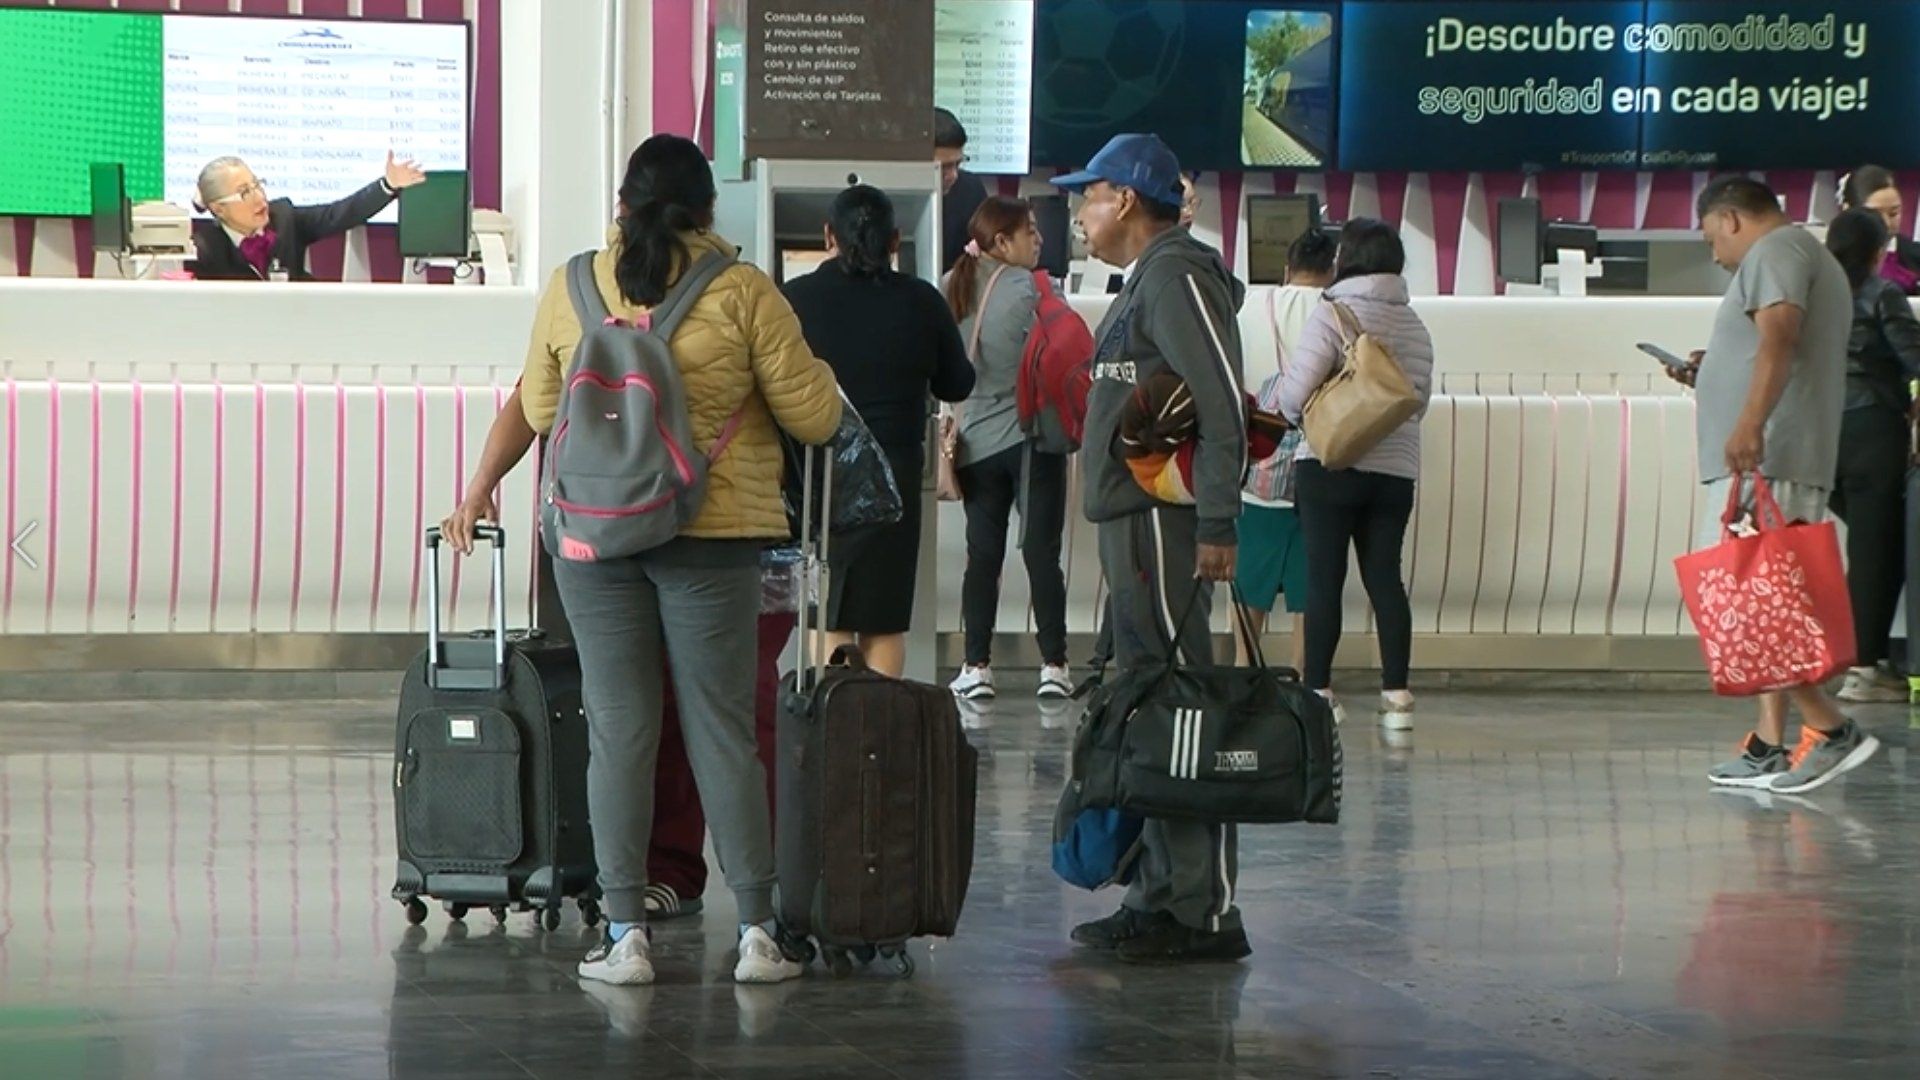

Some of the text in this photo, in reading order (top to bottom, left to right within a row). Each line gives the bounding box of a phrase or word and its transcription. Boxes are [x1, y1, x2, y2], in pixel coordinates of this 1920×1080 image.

[765, 11, 866, 24] Consulta de saldos
[764, 28, 843, 39] y movimientos
[1425, 13, 1868, 58] ¡Descubre comodidad y
[764, 43, 861, 55] Retiro de efectivo
[764, 59, 857, 70] con y sin plástico
[764, 73, 845, 84] Cambio de NIP
[764, 89, 881, 101] Activación de Tarjetas
[1418, 77, 1870, 124] seguridad en cada viaje!
